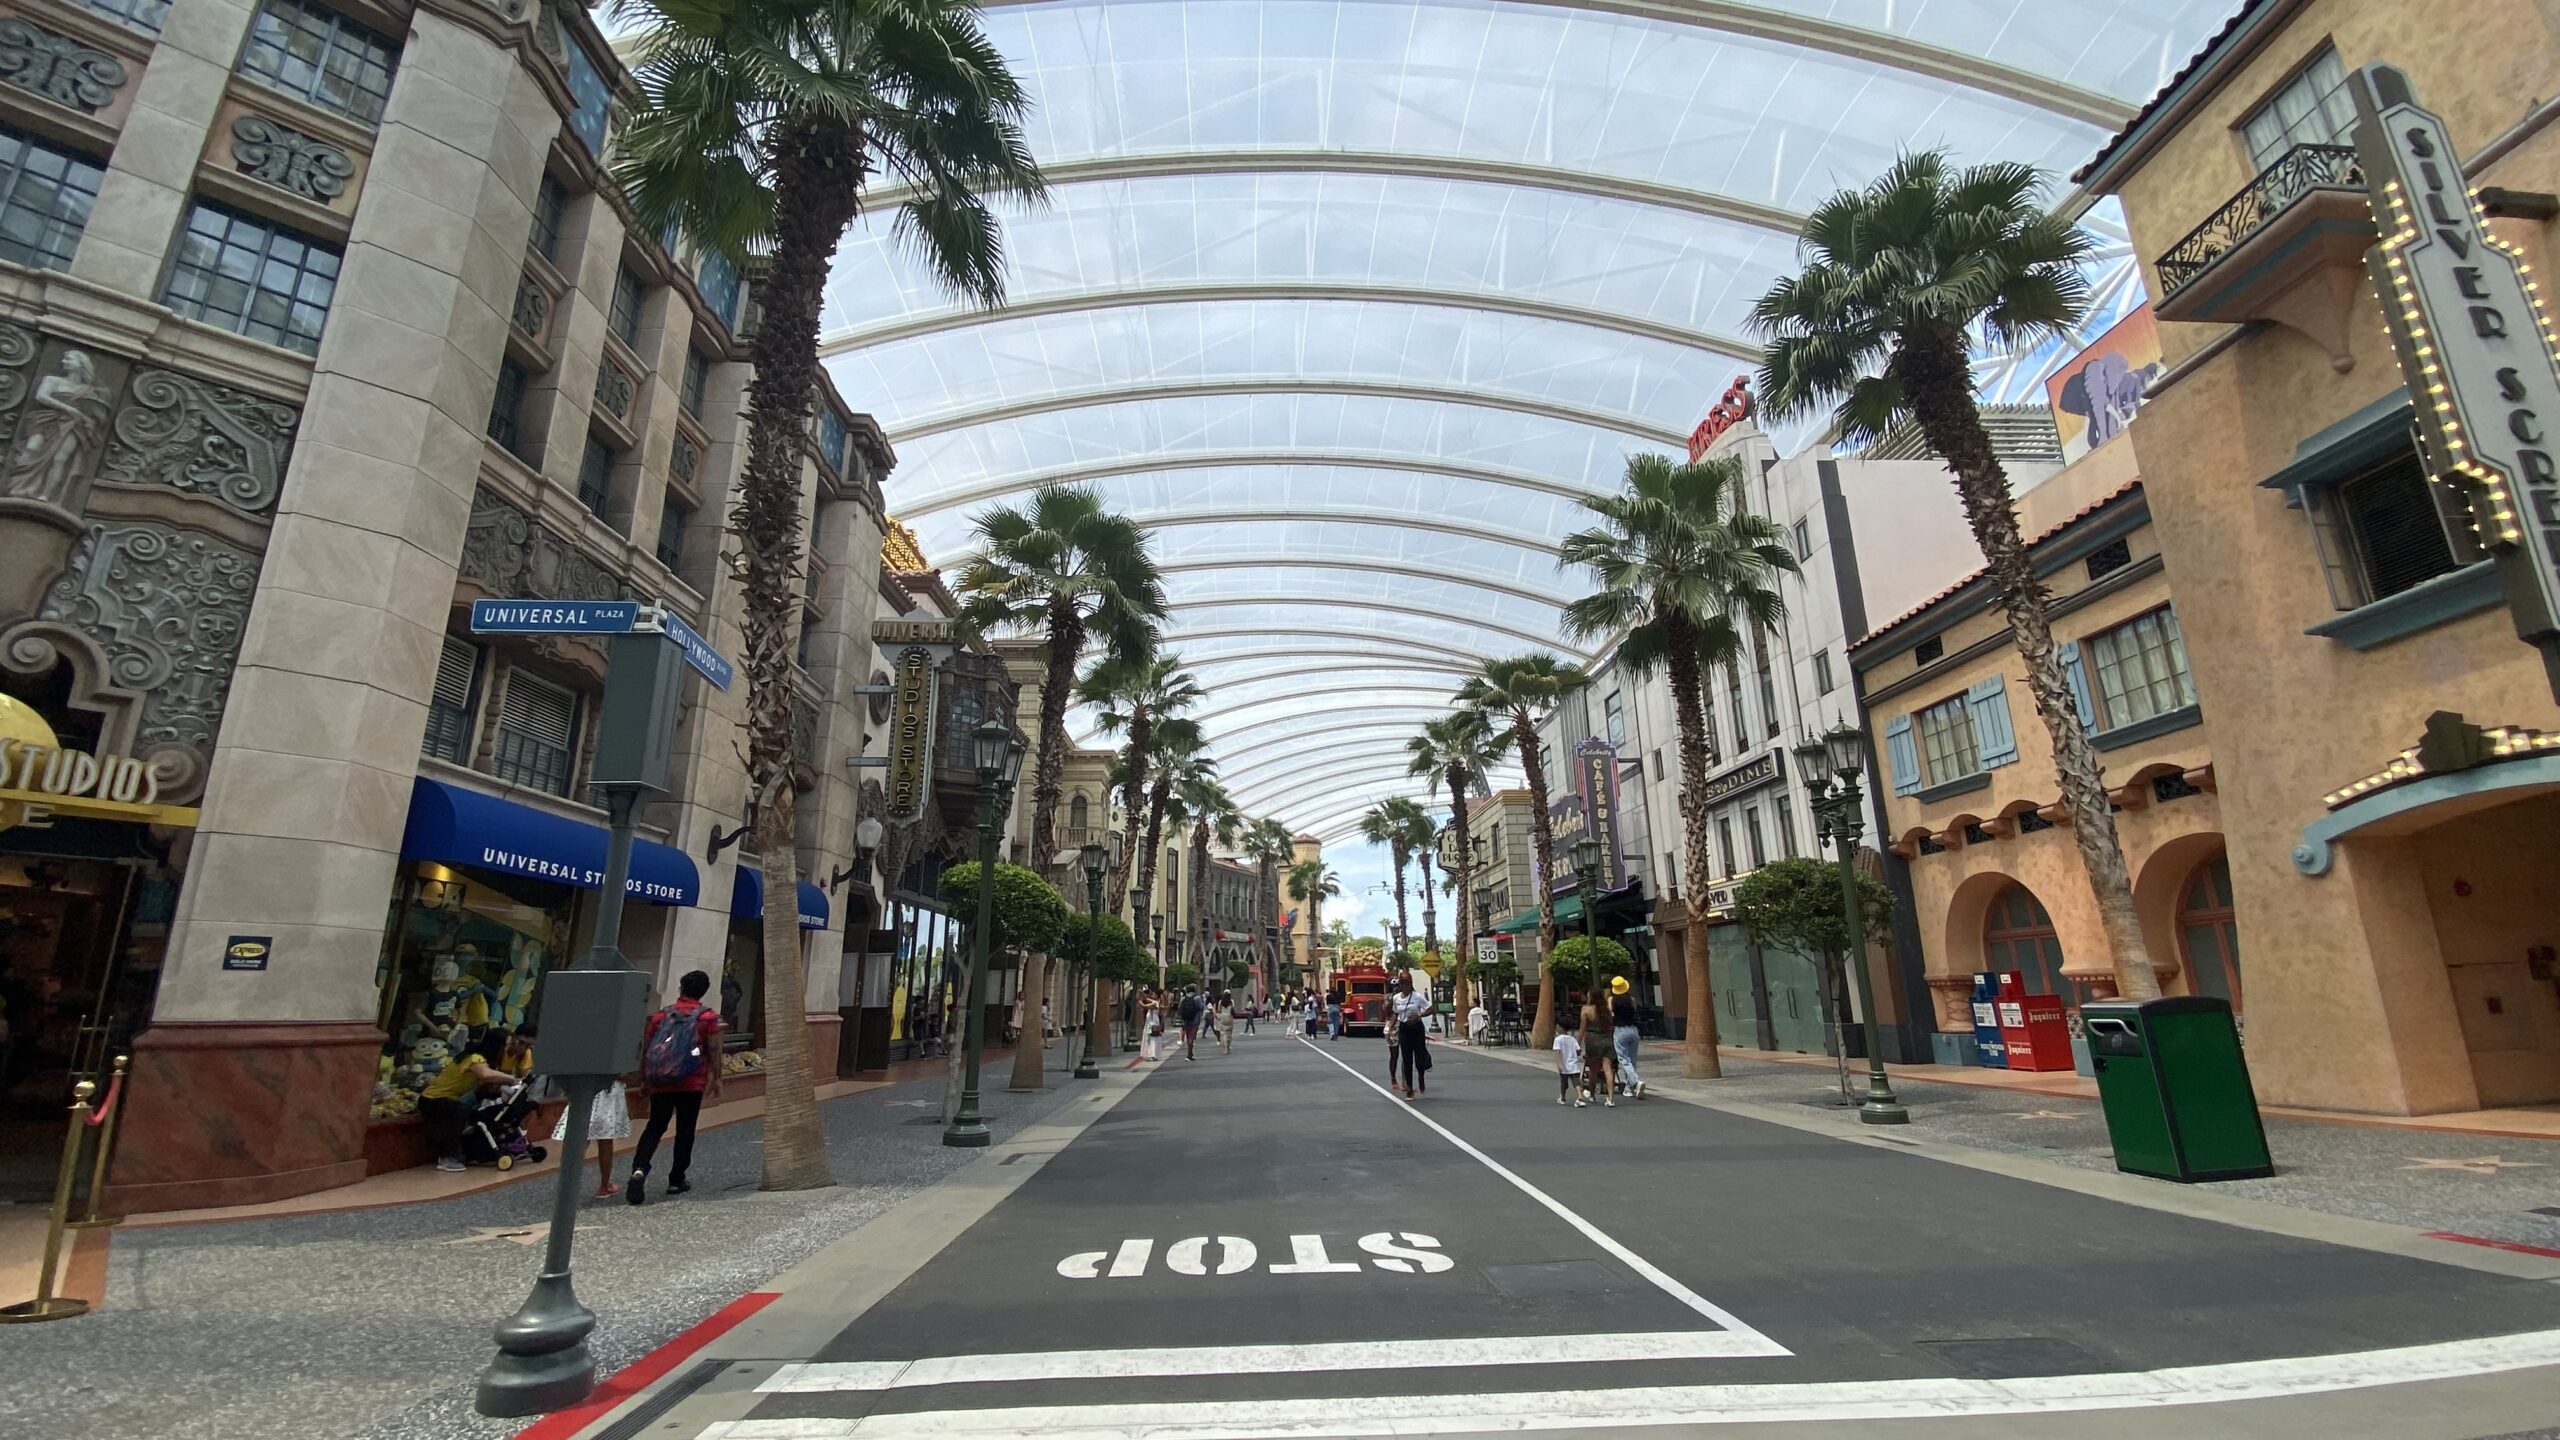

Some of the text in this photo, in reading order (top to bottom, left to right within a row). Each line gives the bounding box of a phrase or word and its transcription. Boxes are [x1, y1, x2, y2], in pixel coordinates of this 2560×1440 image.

[2405, 127, 2560, 590] SILVER SCRE
[484, 607, 624, 625] UNIVERSAL PLAZA
[671, 624, 716, 672] HOLLYWOOD
[896, 653, 922, 806] STUDIOS STORE
[1579, 748, 1613, 758] Celebrity
[0, 737, 160, 805] STUDIOS
[1728, 760, 1772, 789] DIME
[483, 847, 684, 900] UNIVERSAL STOS STORE
[1480, 950, 1497, 960] 30
[1056, 1232, 1456, 1279] STOP
